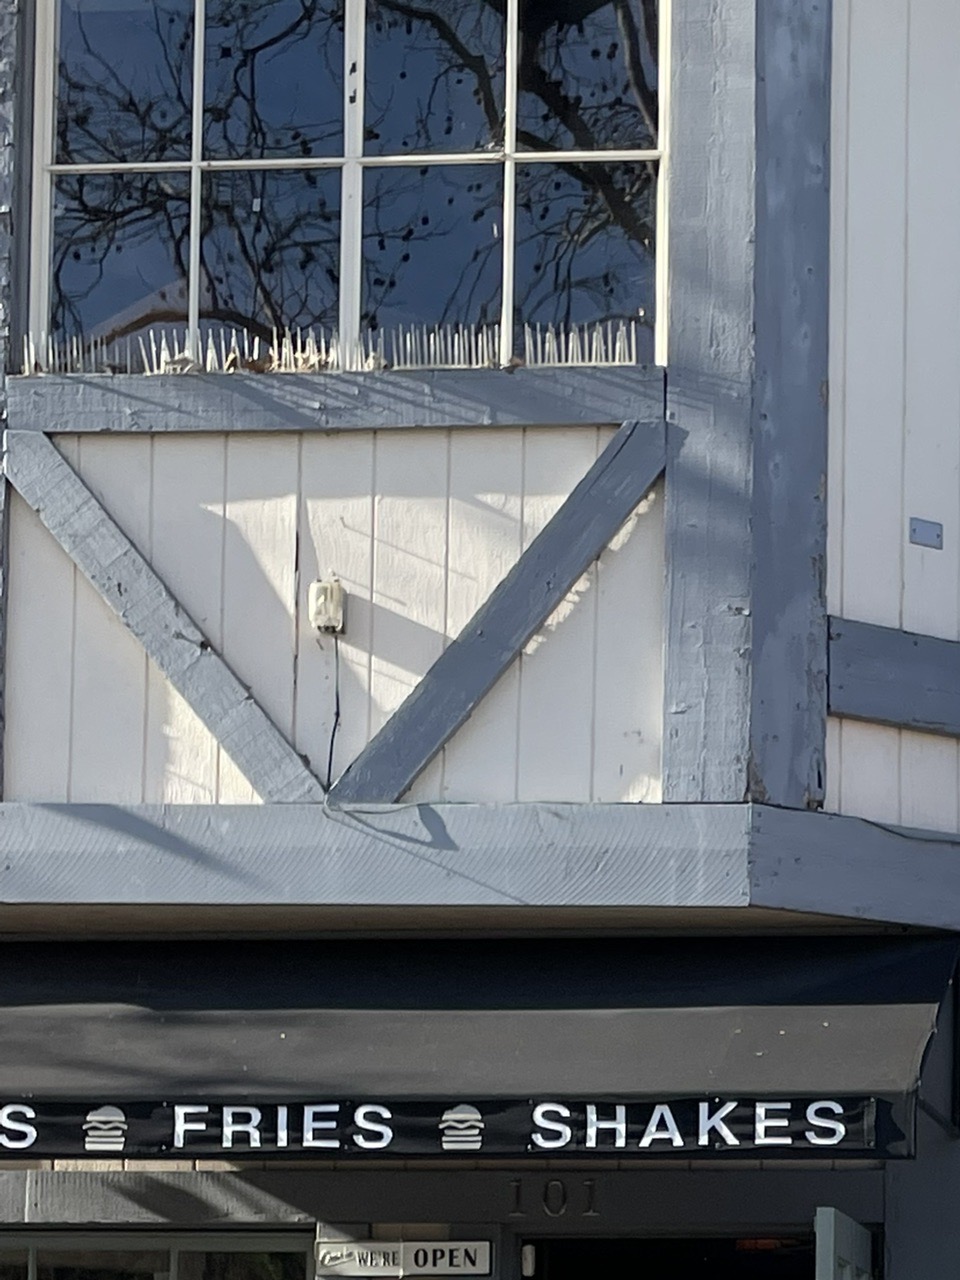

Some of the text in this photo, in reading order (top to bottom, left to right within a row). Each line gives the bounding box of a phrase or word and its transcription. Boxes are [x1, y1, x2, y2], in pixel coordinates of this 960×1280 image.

[173, 1105, 393, 1149] FRIES
[531, 1100, 846, 1149] SHAKES
[507, 1178, 600, 1218] 101
[356, 1250, 399, 1267] WE'RE
[413, 1247, 478, 1268] OPEN
